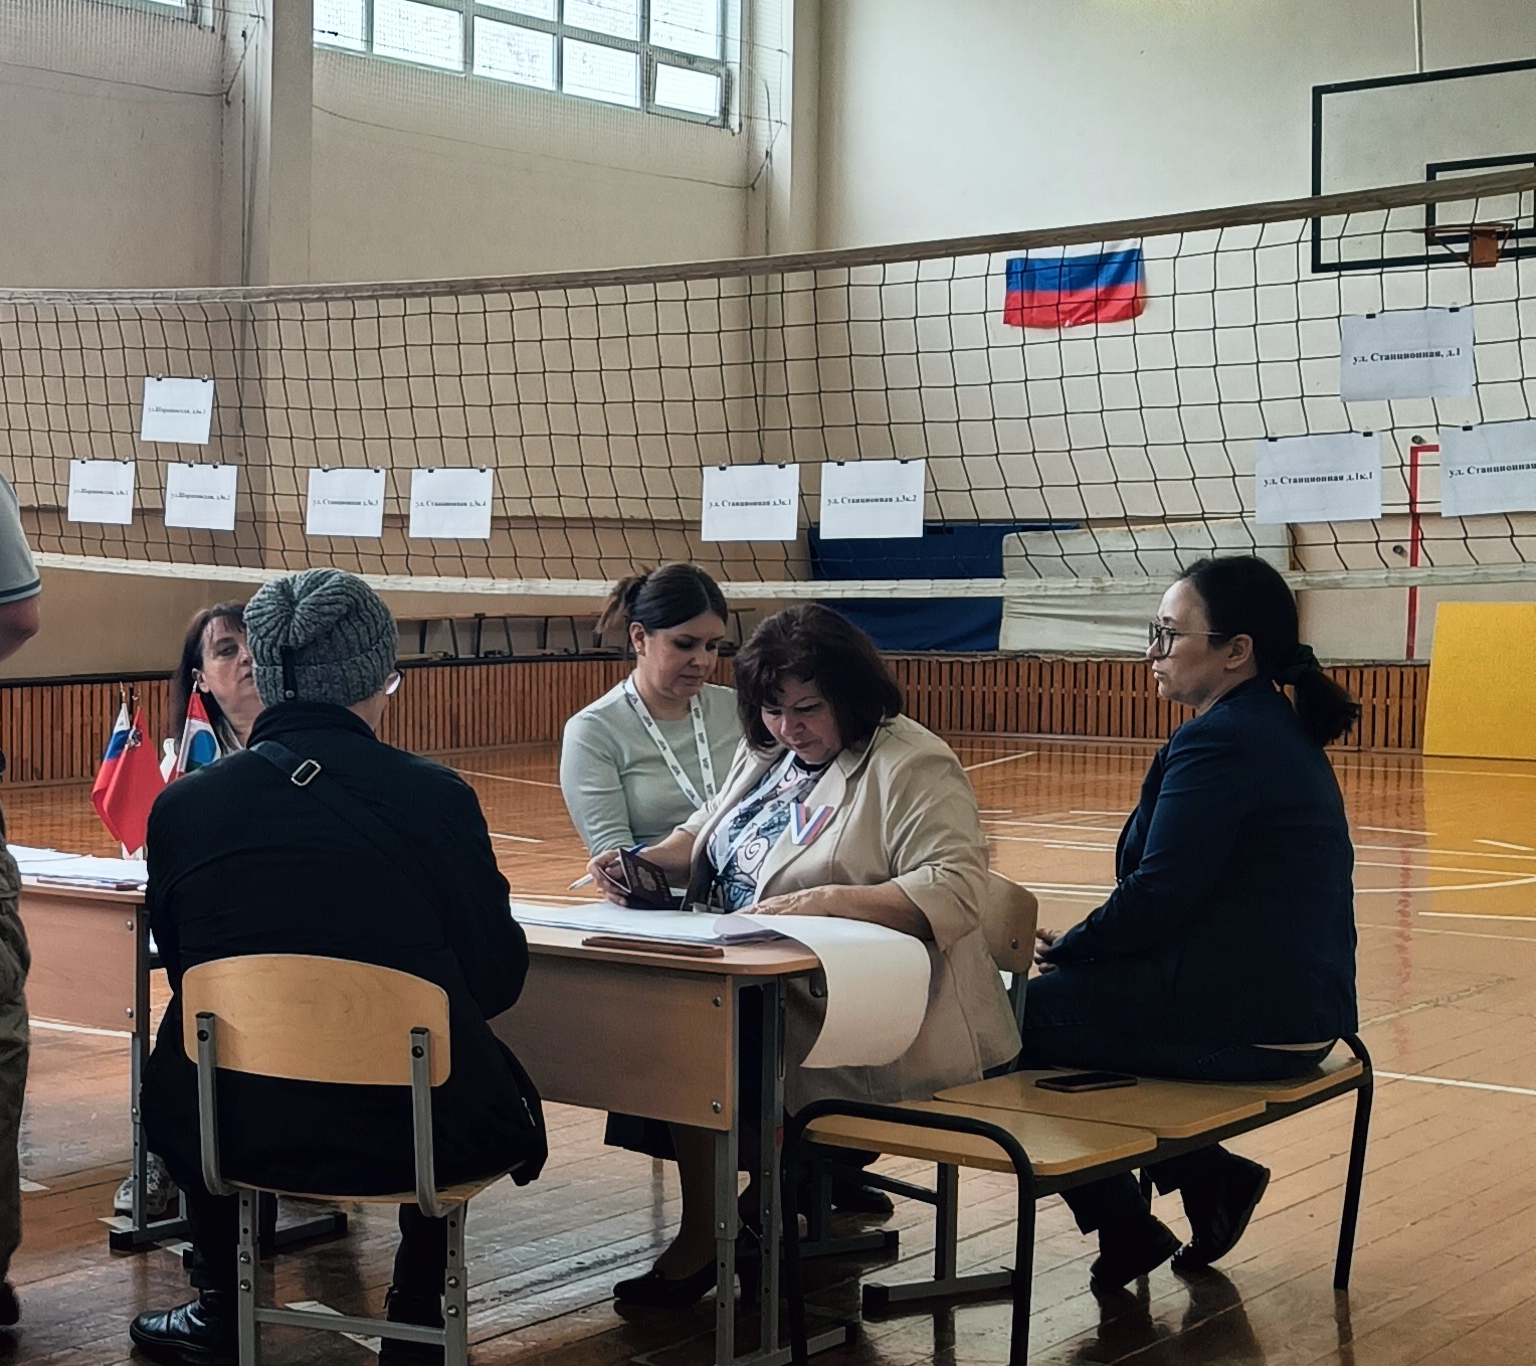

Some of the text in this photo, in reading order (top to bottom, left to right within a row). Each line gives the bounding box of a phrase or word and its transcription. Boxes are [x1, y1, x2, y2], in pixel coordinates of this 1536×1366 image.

[1352, 346, 1461, 366] ул. Станционная, д.1
[1263, 478, 1279, 488] ул.
[1279, 474, 1345, 485] Станционная
[1448, 469, 1465, 479] ул.
